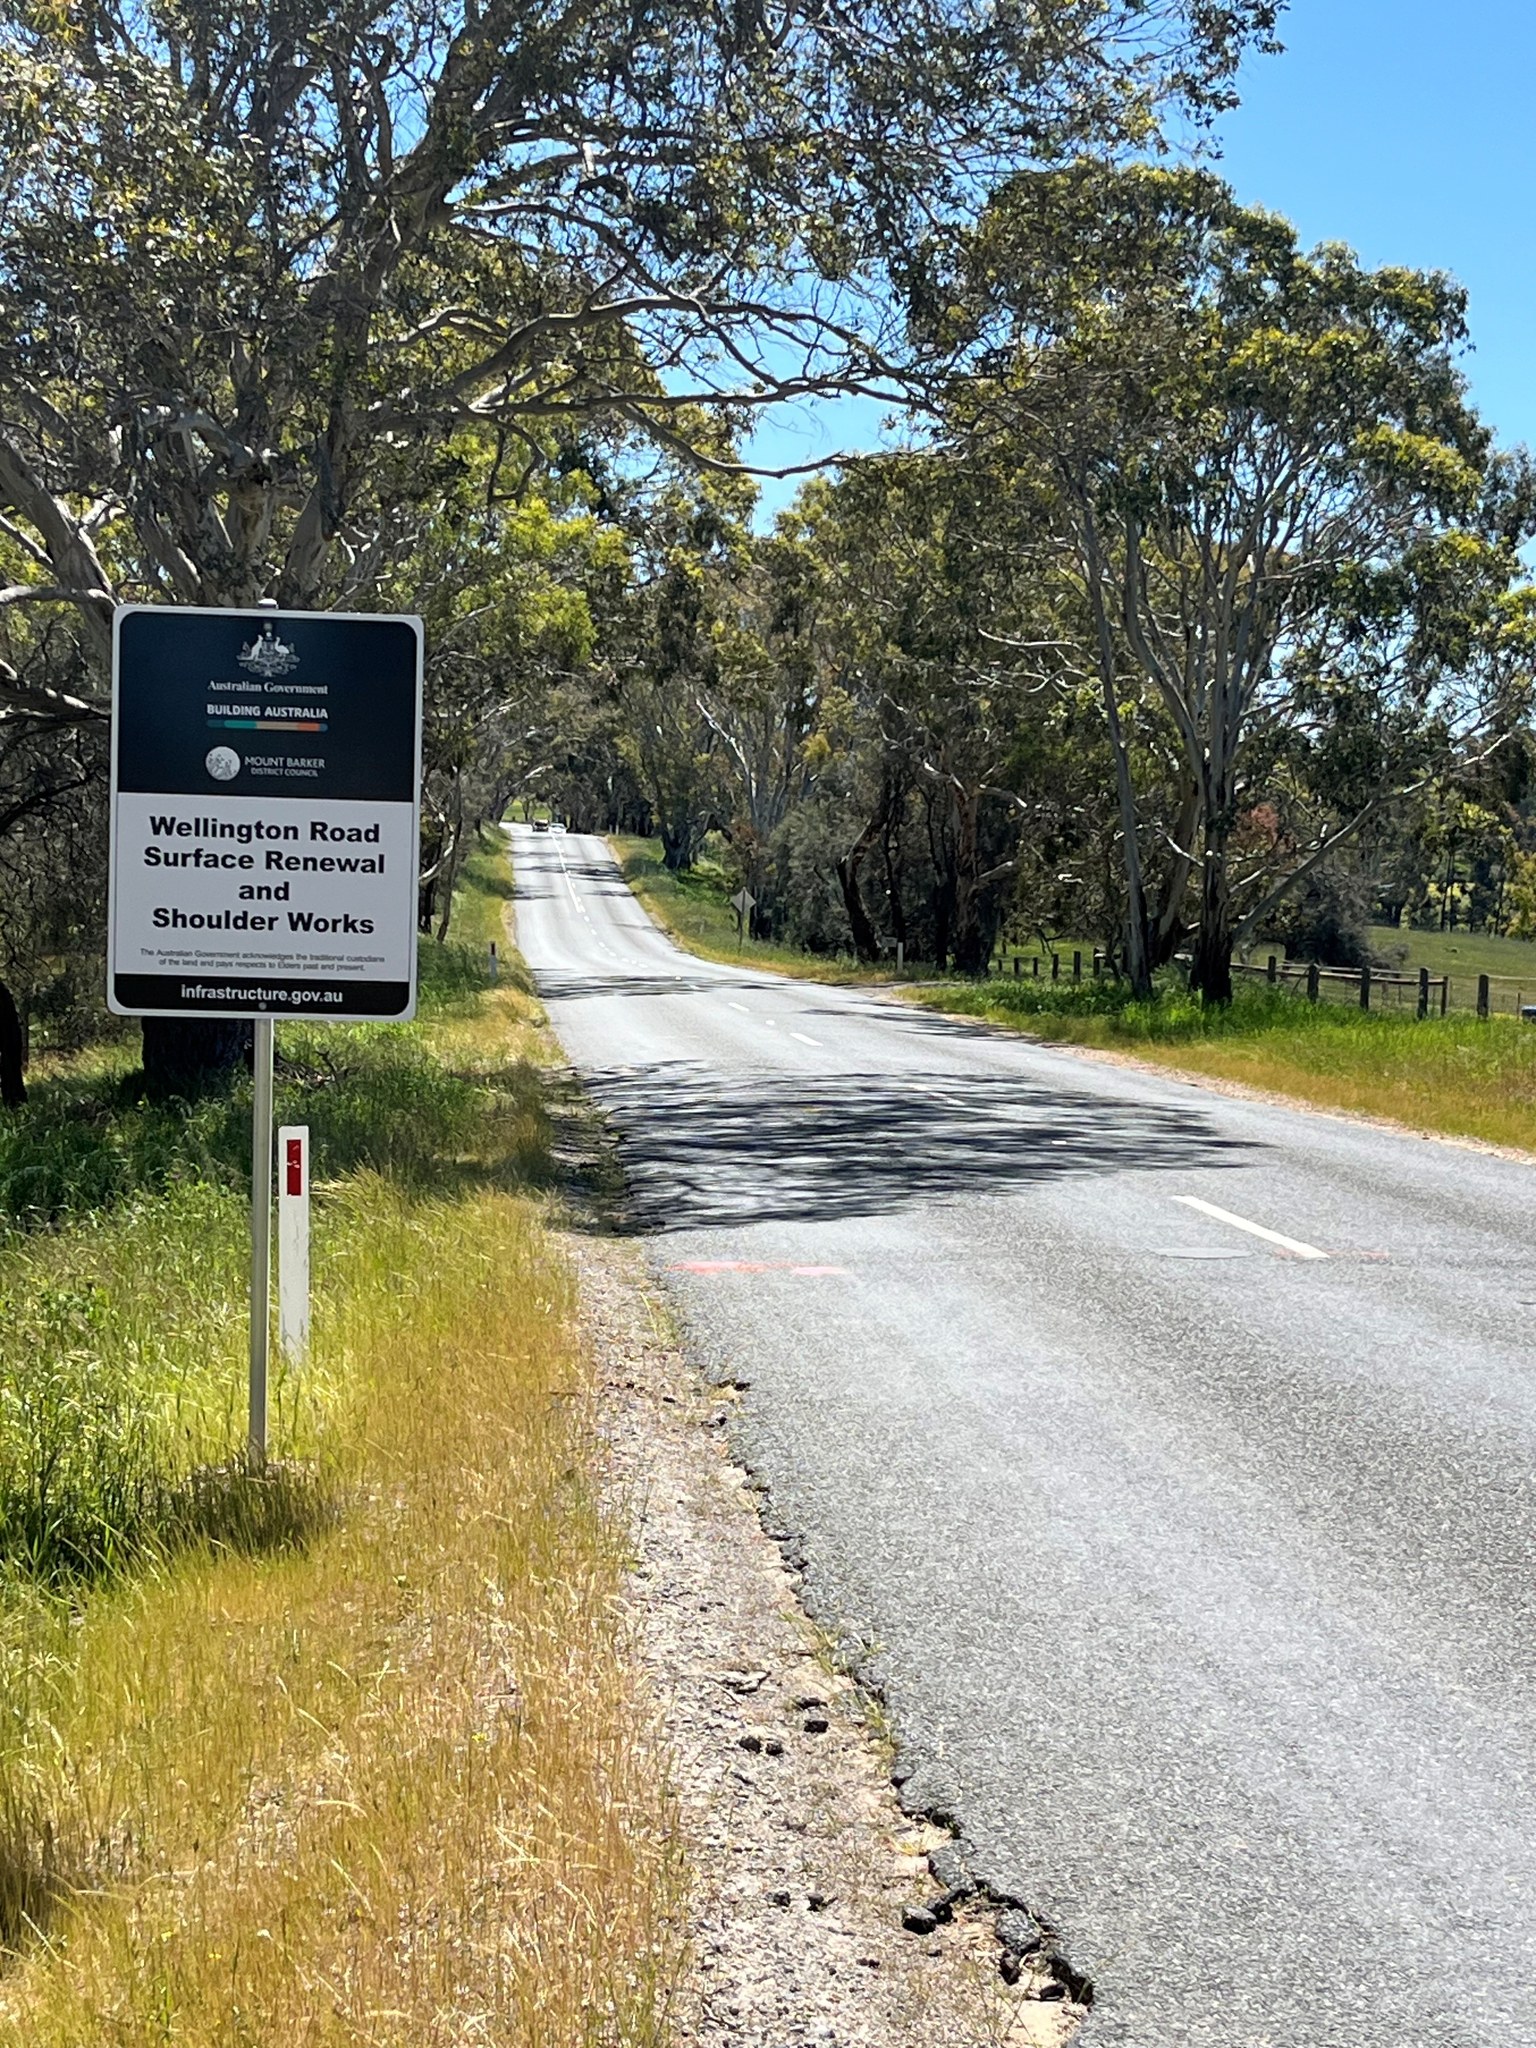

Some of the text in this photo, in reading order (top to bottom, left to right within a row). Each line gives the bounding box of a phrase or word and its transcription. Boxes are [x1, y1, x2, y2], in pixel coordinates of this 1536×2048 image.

[207, 680, 329, 695] Australian Government
[206, 704, 328, 719] BUILDING AUSTRALIA
[244, 756, 325, 768] MOUNT BARKER
[251, 767, 318, 777] DISTRICT COUNCIL
[149, 816, 380, 844] Wellington Road
[143, 846, 385, 874] Surface Renewal
[238, 881, 290, 901] and
[152, 907, 375, 934] Shoulder Works
[140, 948, 154, 956] The
[156, 949, 193, 957] Australian
[194, 950, 240, 958] Government
[295, 953, 307, 961] the
[158, 958, 167, 966] of
[168, 958, 180, 966] the
[181, 983, 343, 1005] infrastructure.gov.au
